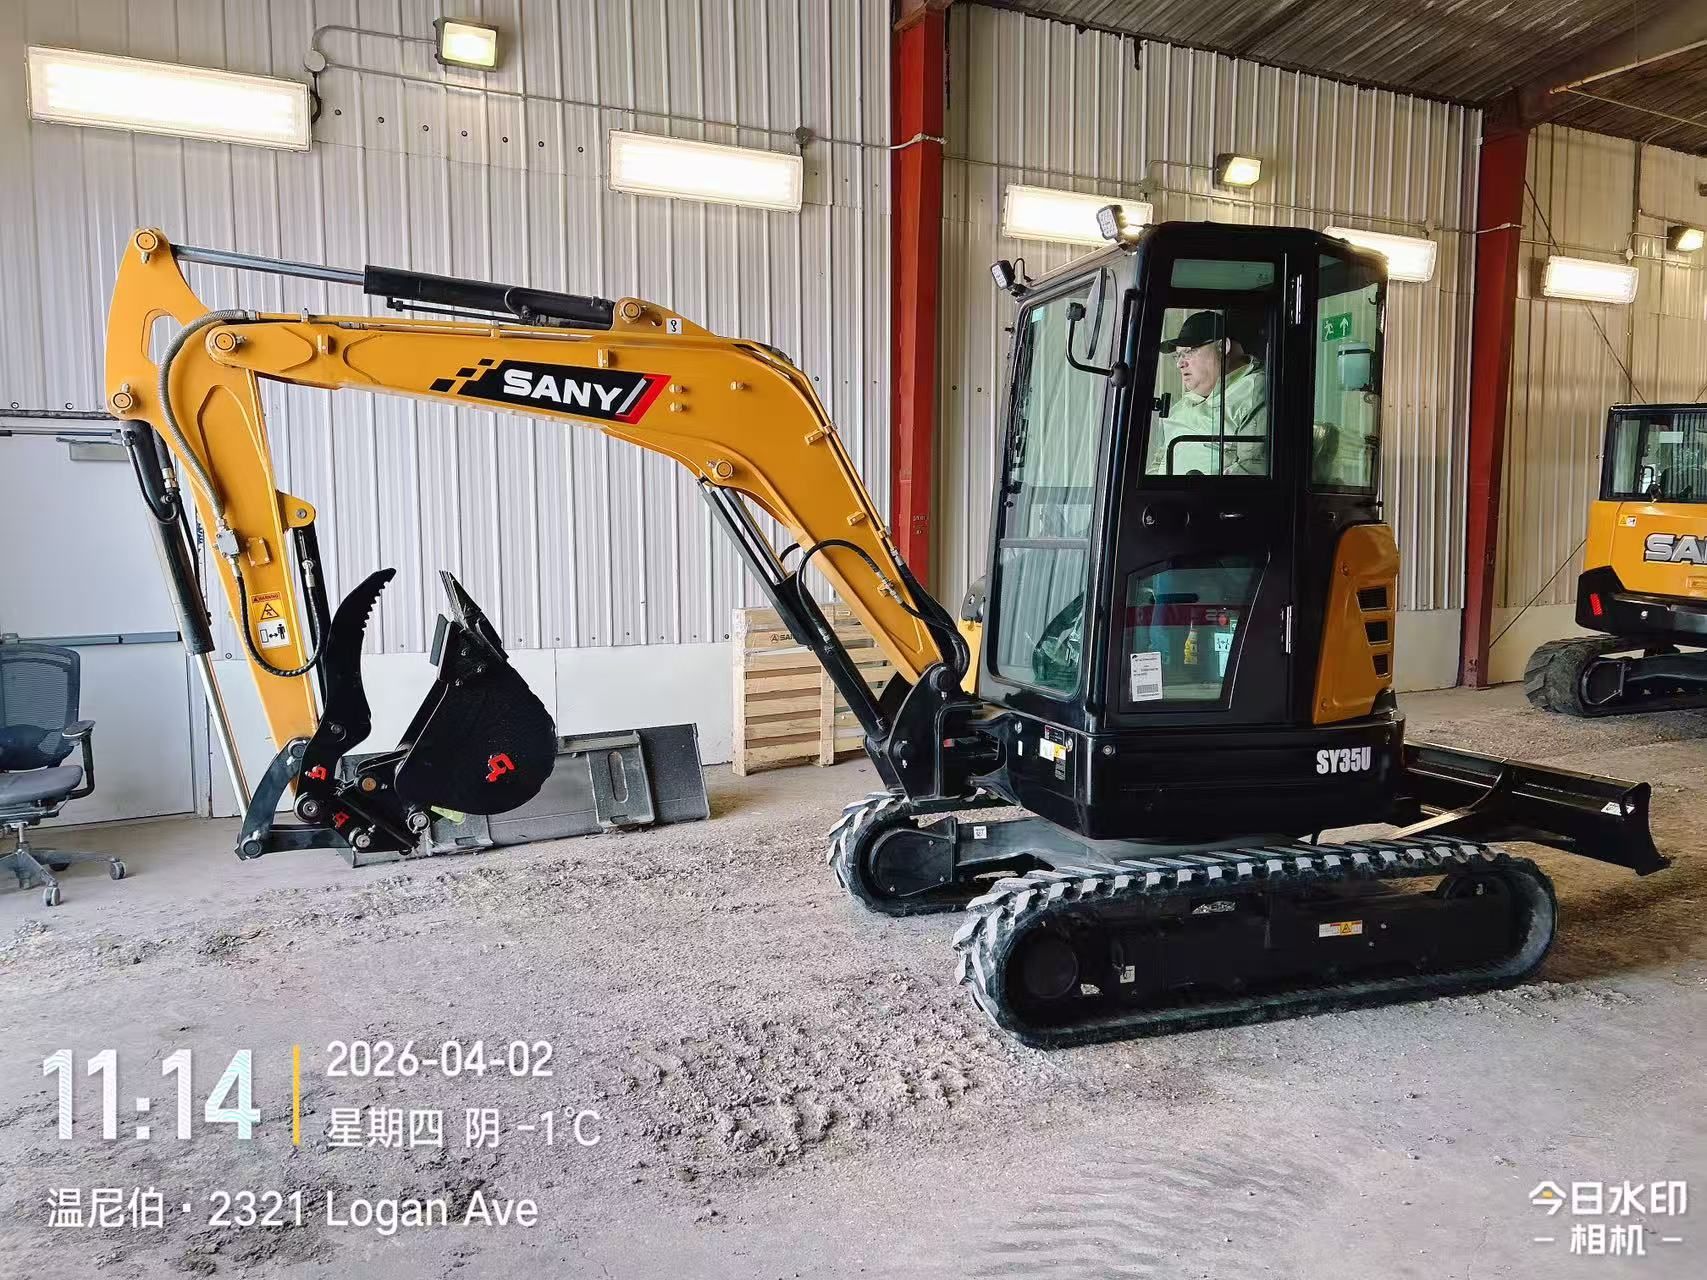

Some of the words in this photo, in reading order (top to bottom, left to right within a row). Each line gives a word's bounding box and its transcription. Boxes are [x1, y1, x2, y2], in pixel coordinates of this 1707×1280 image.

[503, 368, 623, 411] SANY
[1643, 532, 1707, 565] SA
[1316, 746, 1371, 774] SY35U
